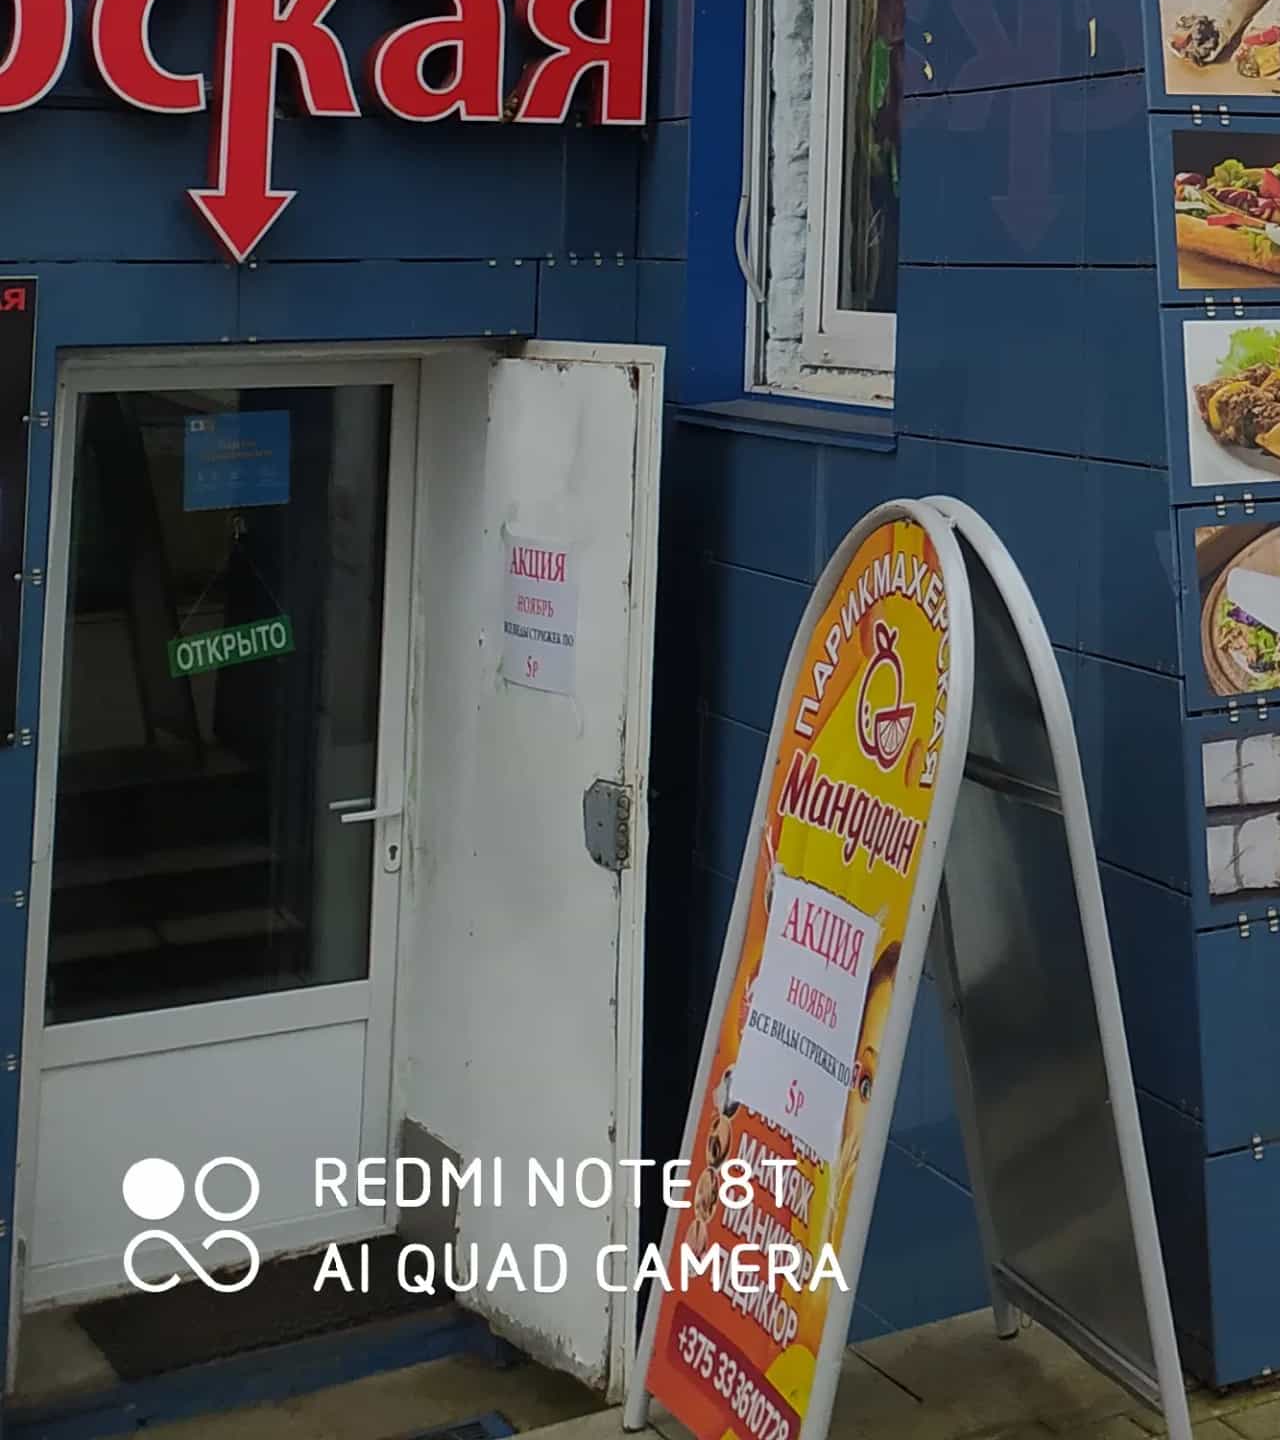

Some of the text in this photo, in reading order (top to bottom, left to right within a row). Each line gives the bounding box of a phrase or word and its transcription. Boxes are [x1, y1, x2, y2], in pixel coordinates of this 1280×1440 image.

[510, 546, 567, 583] АКЦИЯ
[176, 621, 287, 671] ОТКРЫТО
[794, 551, 951, 788] ПАРИКМАХЕРСКАЯ
[778, 749, 923, 877] Мандарин
[780, 897, 865, 978] АКЦИЯ
[786, 974, 838, 1030] НОЯБРЬ
[748, 1008, 770, 1035] ВСЕ
[770, 1018, 800, 1053] ВИДЫ
[799, 1034, 838, 1079] СТРИЖЕК
[678, 1325, 717, 1379] +375
[713, 1352, 737, 1398] 33
